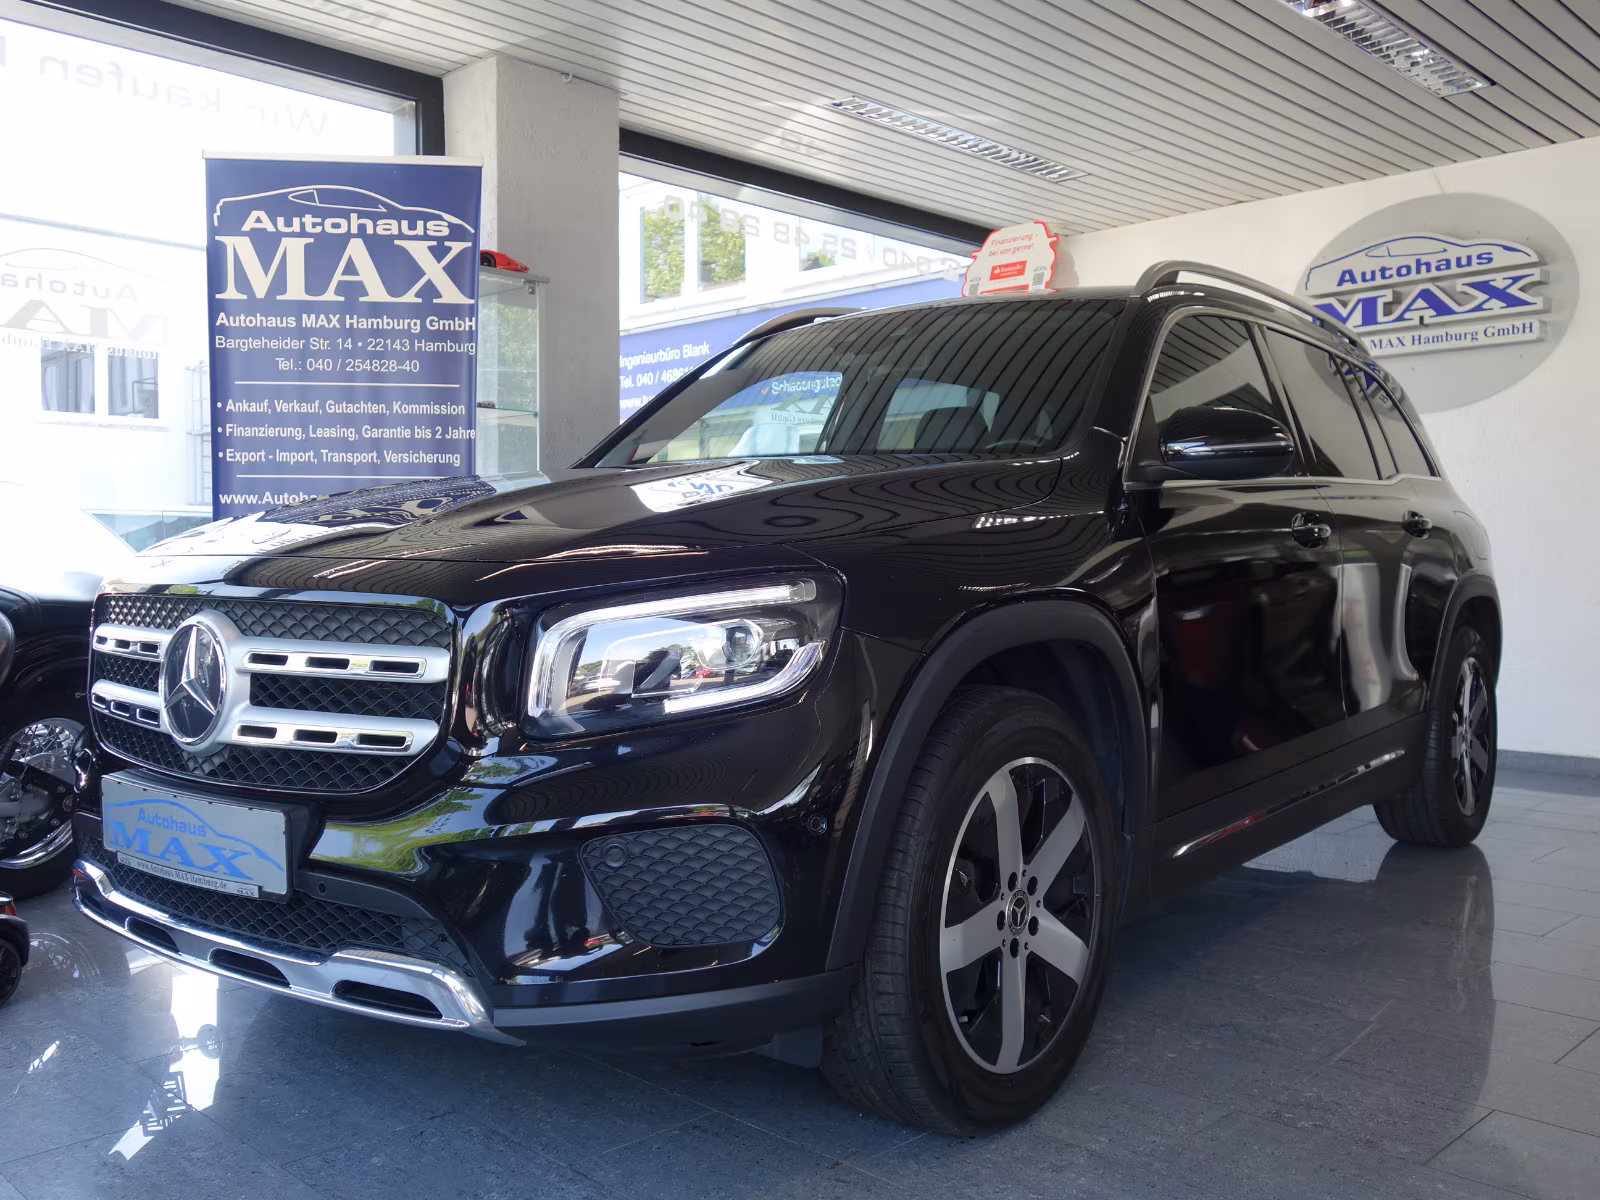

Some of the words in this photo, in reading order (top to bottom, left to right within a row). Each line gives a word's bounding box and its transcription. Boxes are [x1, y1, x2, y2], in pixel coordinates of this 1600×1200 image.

[241, 210, 450, 236] Autohaus
[214, 235, 475, 304] MAX
[1336, 251, 1495, 286] Autohaus
[1312, 273, 1538, 328] MAX
[215, 312, 296, 328] Autohaus
[302, 313, 341, 329] MAX
[345, 315, 421, 333] Hamburg
[425, 316, 476, 331] GmbH
[215, 336, 305, 352] Bargteheider
[309, 337, 332, 350] Str.
[336, 338, 353, 350] 14
[367, 338, 410, 351] 22143
[415, 339, 477, 355] Hamburg
[1370, 335, 1406, 350] MAX
[1411, 331, 1479, 346] Hamburg
[1483, 321, 1534, 339] GmbH
[275, 357, 302, 371] Tel.:
[306, 358, 333, 372] 040
[337, 358, 342, 372] /
[345, 359, 420, 373] 254828-40
[619, 347, 681, 370] Ingenieurbüro
[682, 340, 710, 358] Blank
[619, 374, 635, 389] Tel.
[636, 371, 654, 387] 040
[226, 399, 271, 414] Ankauf,
[274, 400, 322, 415] Verkauf,
[326, 400, 390, 416] Gutachten,
[392, 401, 466, 416] Kommission
[226, 424, 306, 440] Finanzierung,
[309, 425, 359, 440] Leasing,
[362, 425, 411, 439] Garantie
[415, 426, 432, 439] bis
[435, 426, 443, 439] 2
[445, 426, 476, 440] Jahre
[226, 448, 266, 465] Export
[276, 449, 317, 465] Import,
[321, 449, 381, 466] Transport,
[384, 450, 461, 467] Versicherung
[137, 807, 207, 837] Autohaus
[109, 819, 255, 880] MAX
[236, 888, 255, 897] MAX
